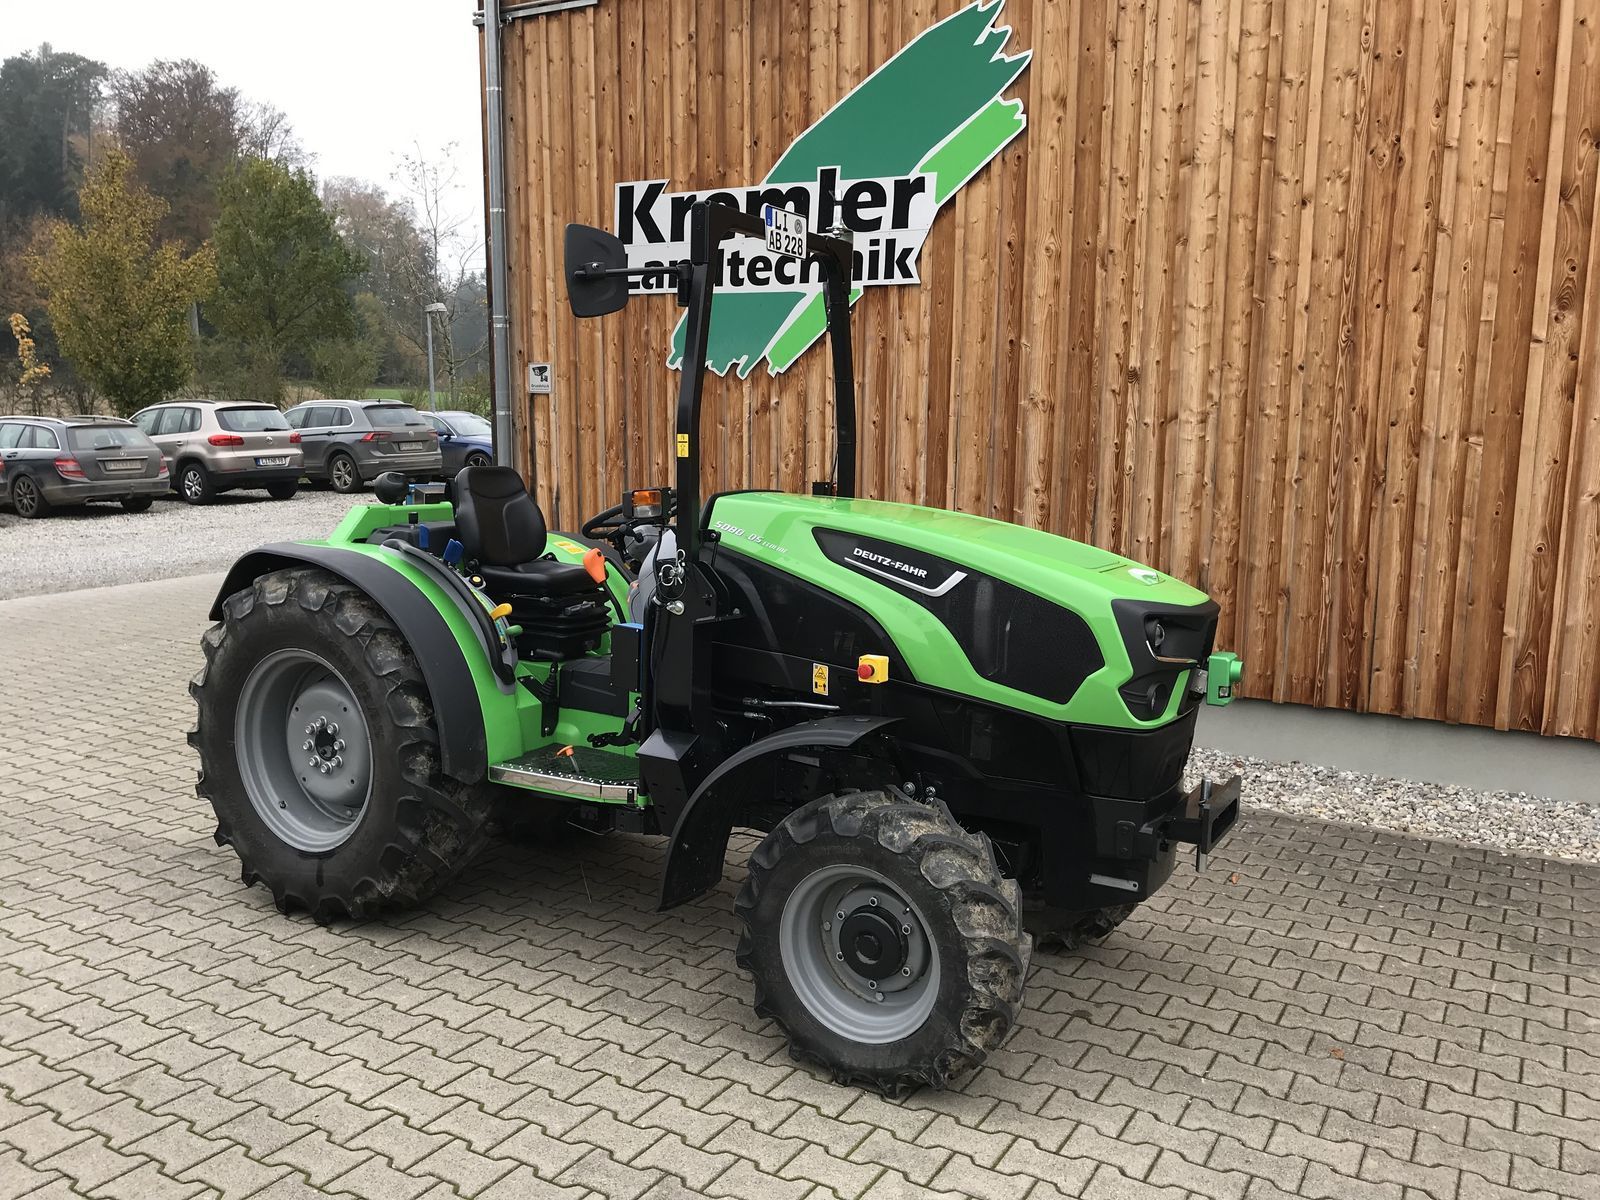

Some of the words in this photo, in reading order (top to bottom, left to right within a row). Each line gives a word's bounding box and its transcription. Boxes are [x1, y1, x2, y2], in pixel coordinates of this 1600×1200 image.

[775, 210, 788, 232] LI
[769, 230, 782, 251] AB
[784, 234, 803, 256] 228
[624, 237, 914, 290] antechik
[714, 520, 745, 536] 5080
[853, 547, 928, 579] DEUTZ-FAHR
